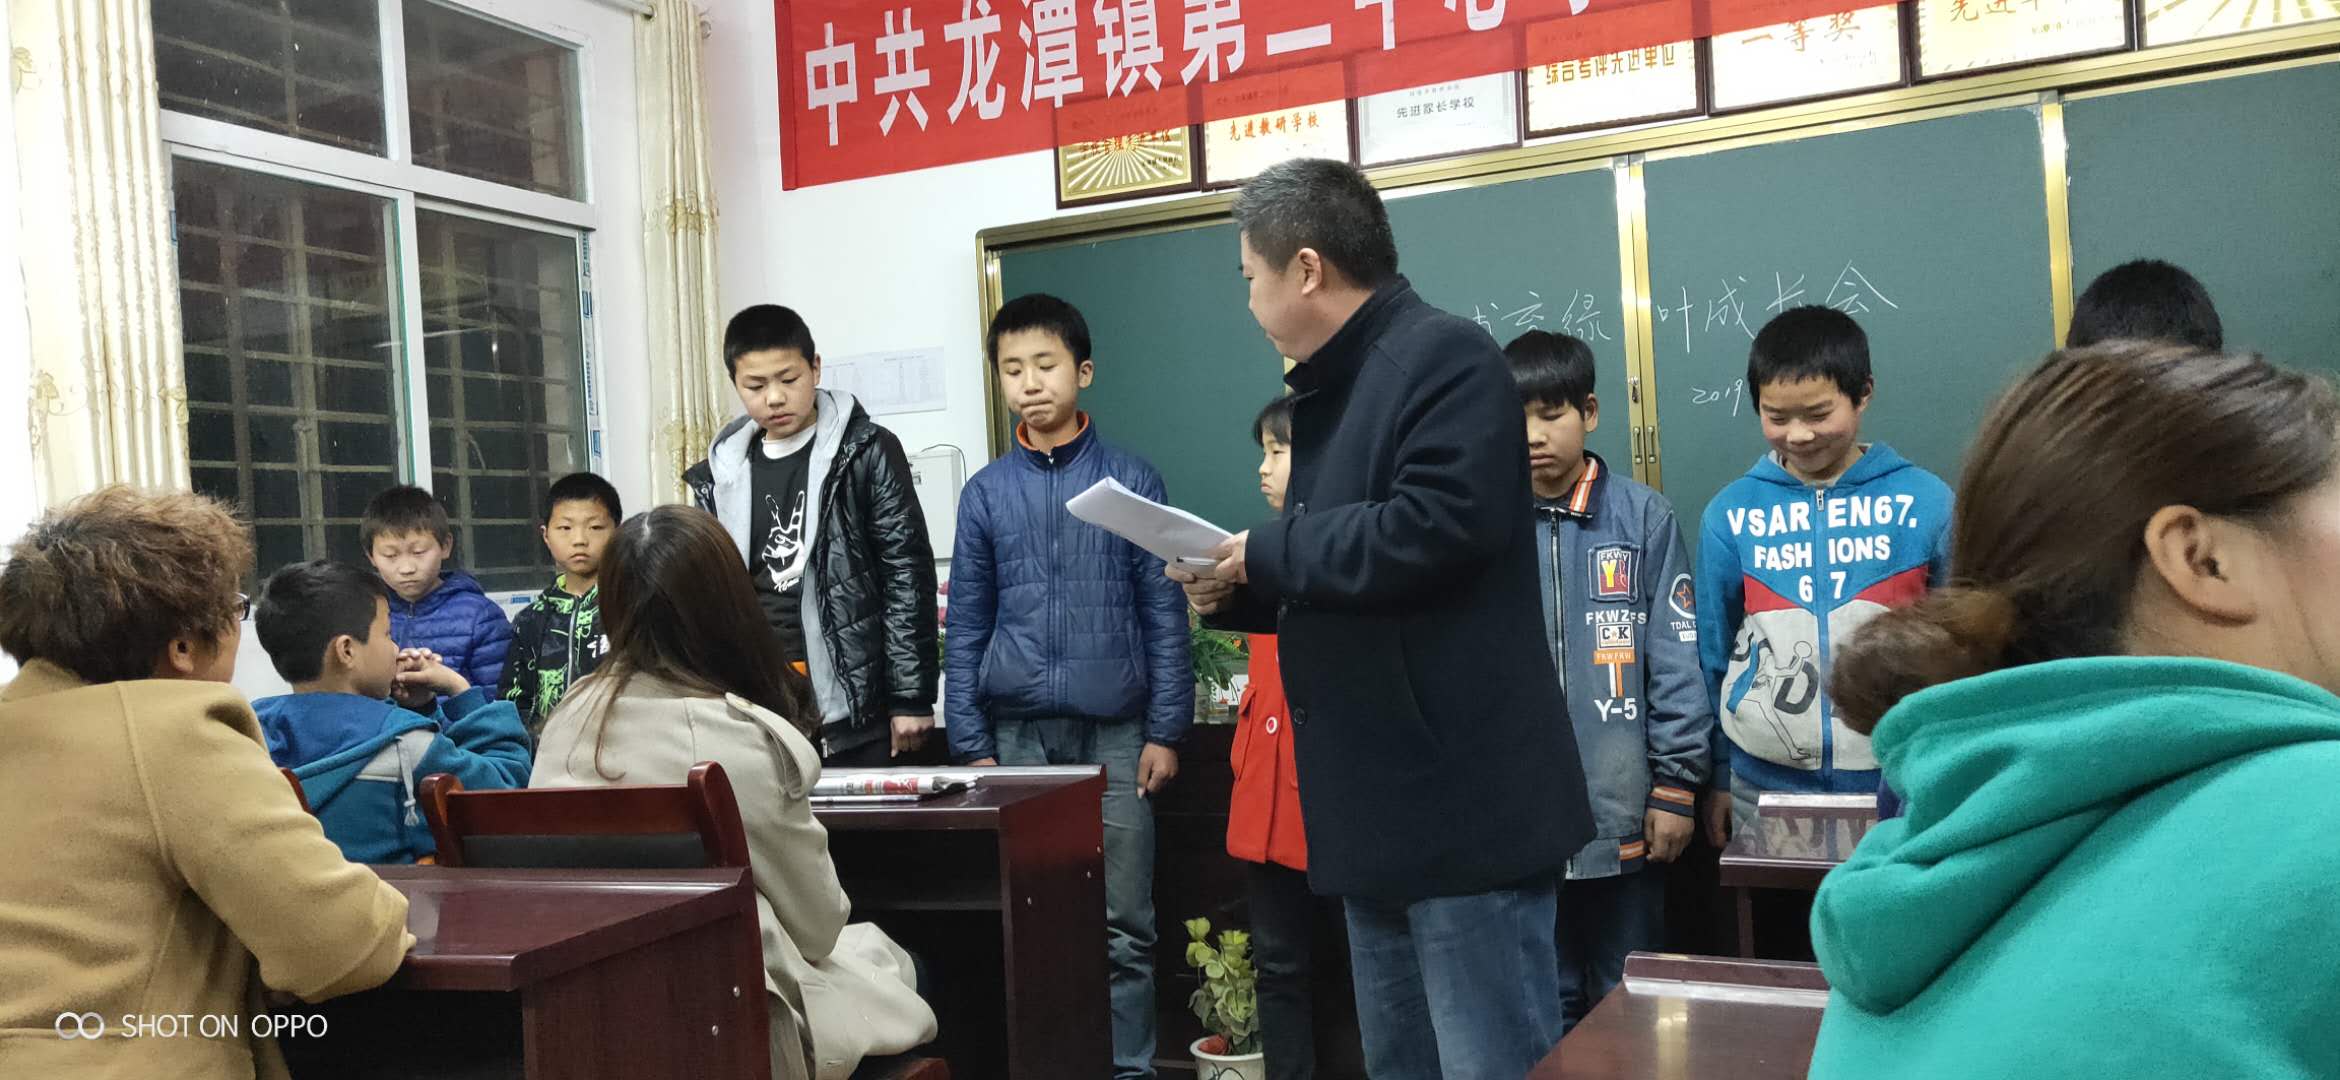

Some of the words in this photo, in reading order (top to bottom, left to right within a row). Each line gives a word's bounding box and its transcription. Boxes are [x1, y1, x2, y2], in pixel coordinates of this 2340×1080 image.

[1741, 12, 1860, 52] 一等奖
[805, 0, 1592, 146] 中共龙潭镇第二
[1396, 96, 1475, 119] 先进家长学校
[1230, 111, 1320, 141] 先进教研学校
[1691, 378, 1743, 417] 2019
[1586, 609, 1648, 626] FKWZFS
[1594, 698, 1638, 722] Y-5
